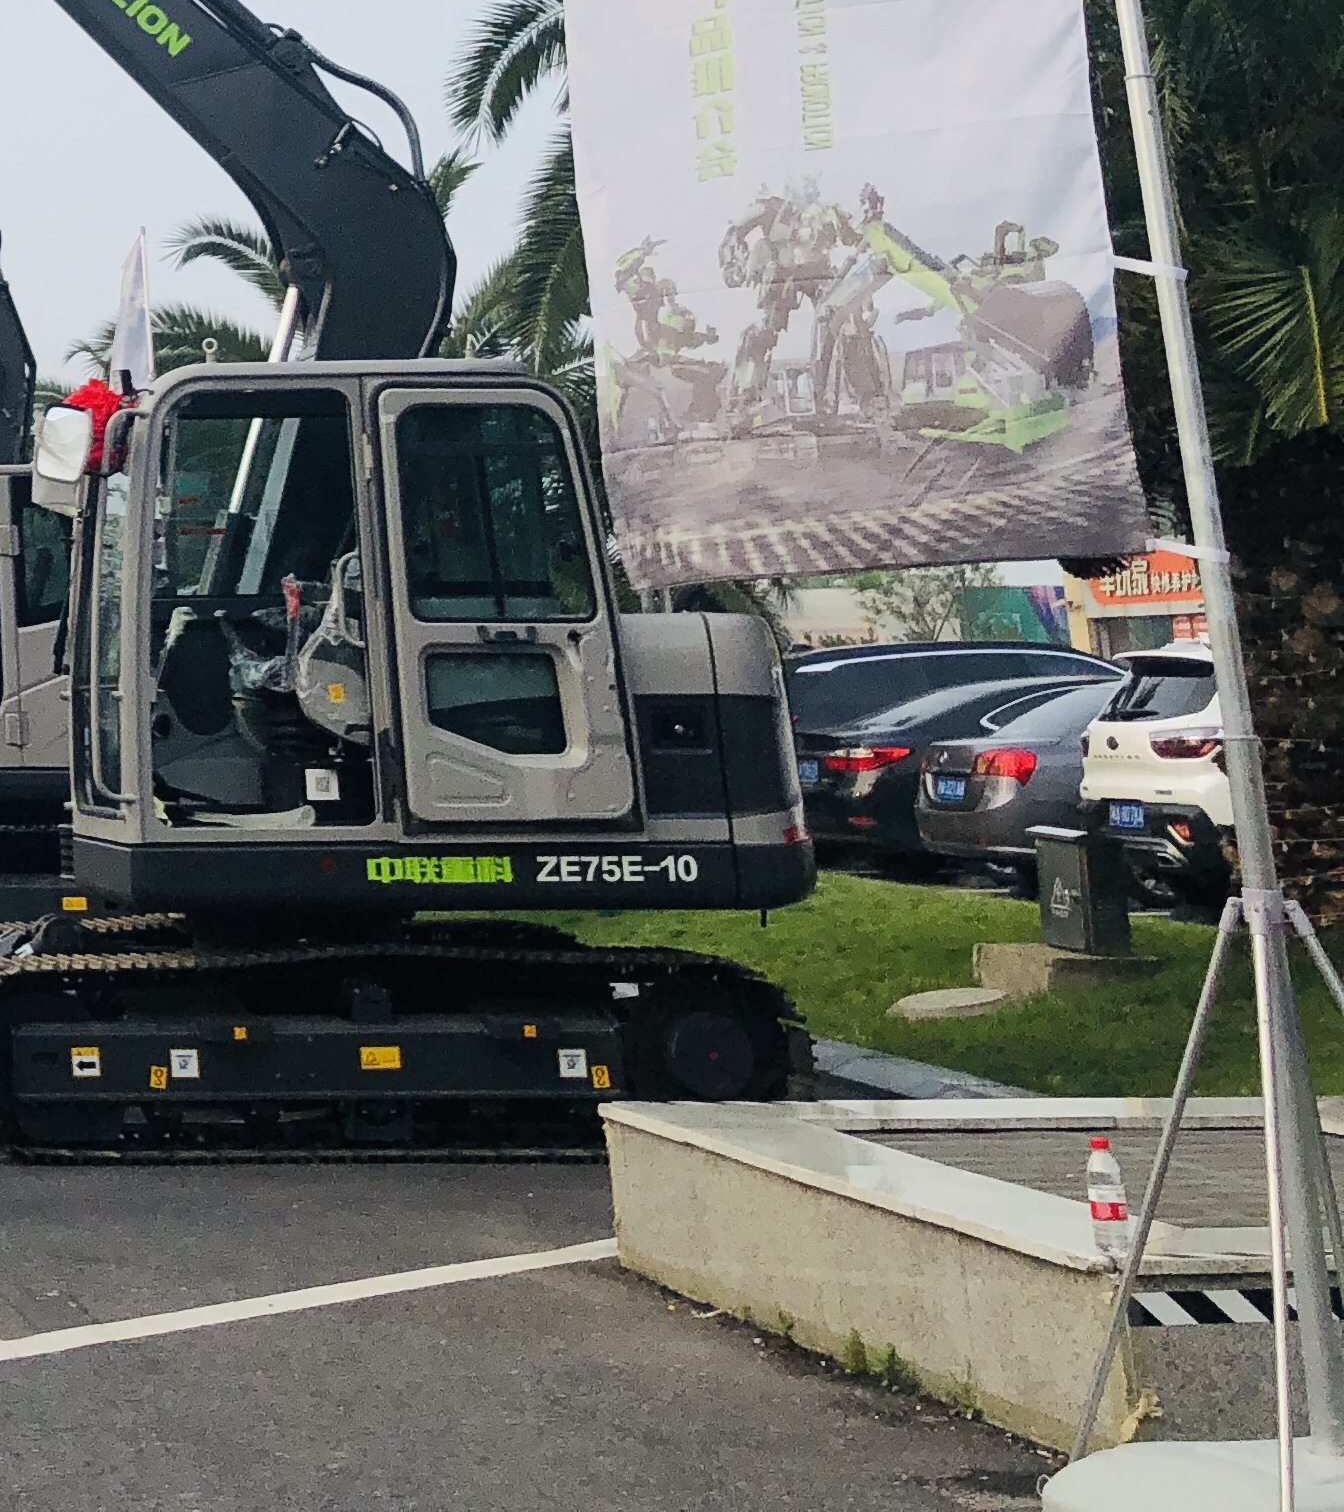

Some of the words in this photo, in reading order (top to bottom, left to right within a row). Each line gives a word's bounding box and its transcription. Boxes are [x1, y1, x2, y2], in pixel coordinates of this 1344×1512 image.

[366, 855, 514, 884] 中联重科
[535, 854, 699, 883] ZE75E-10
